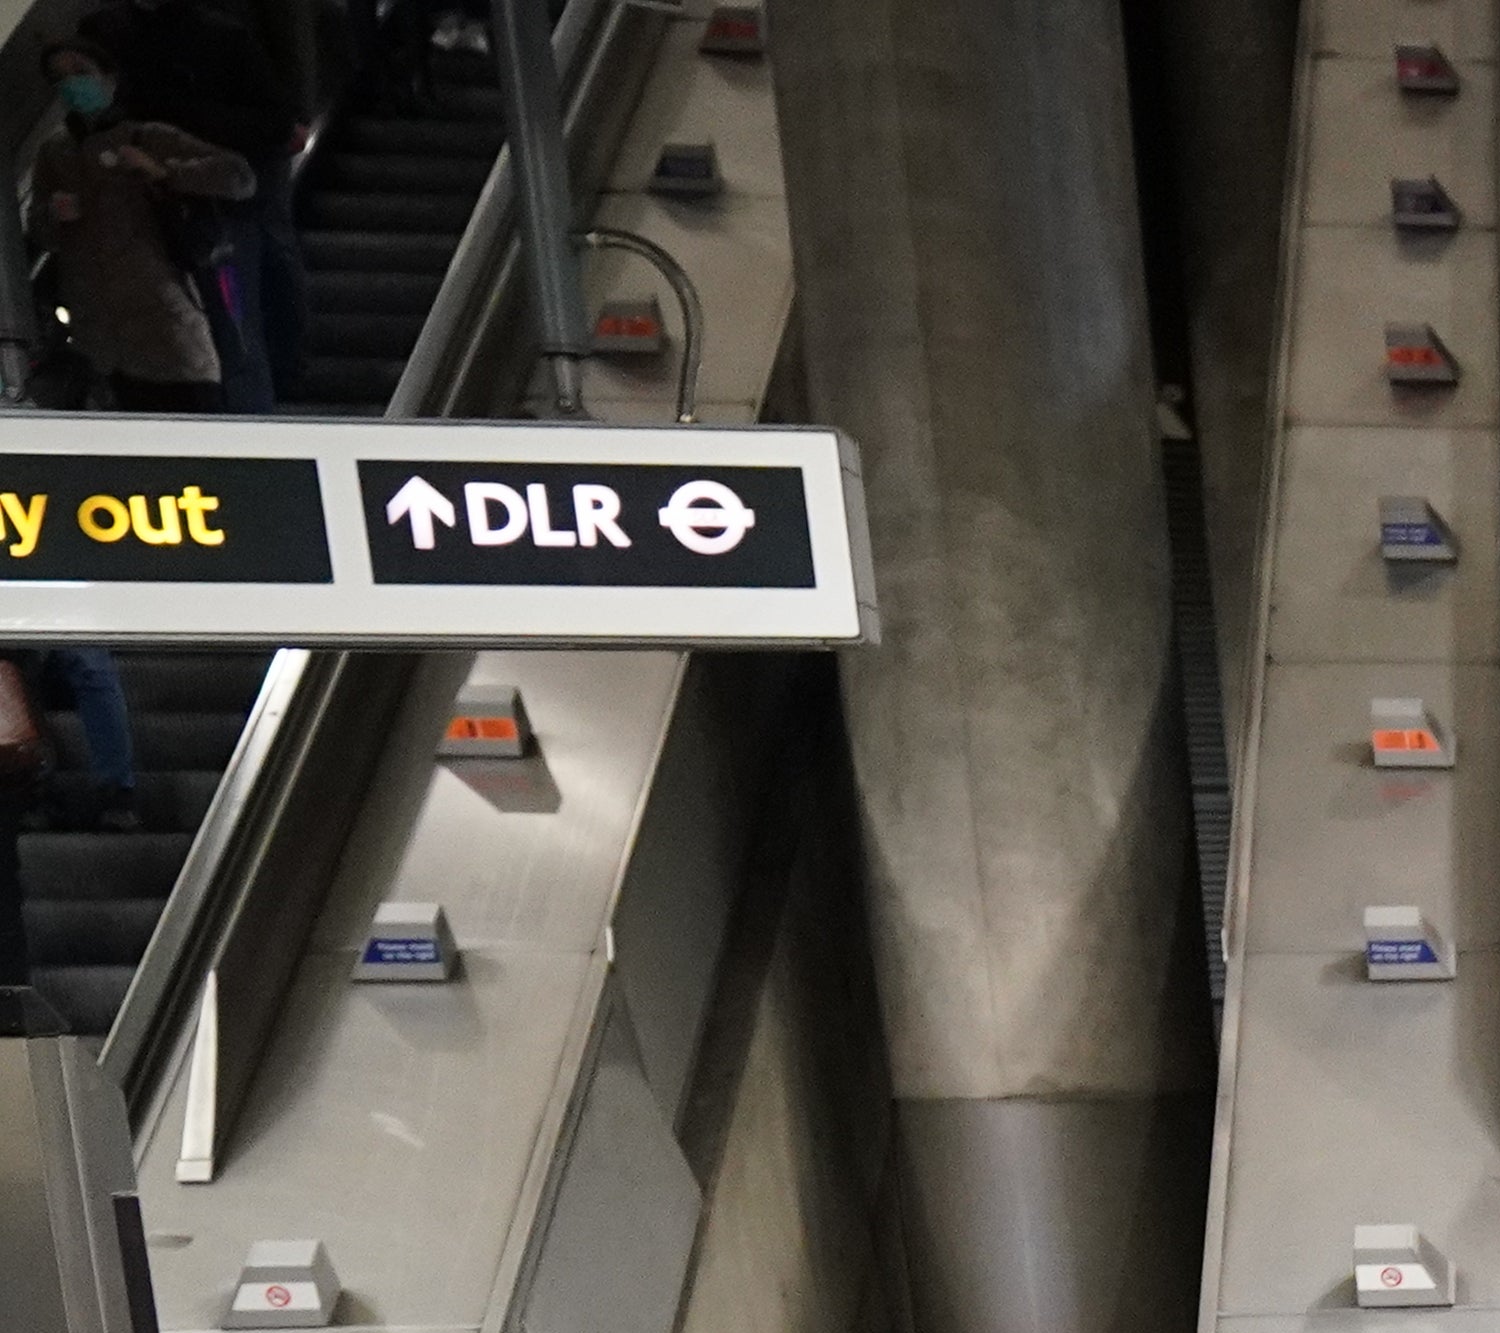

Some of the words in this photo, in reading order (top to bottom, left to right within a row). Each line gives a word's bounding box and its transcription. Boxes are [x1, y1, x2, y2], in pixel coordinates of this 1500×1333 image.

[0, 492, 48, 558] y
[77, 485, 225, 546] out
[464, 481, 632, 548] DLR
